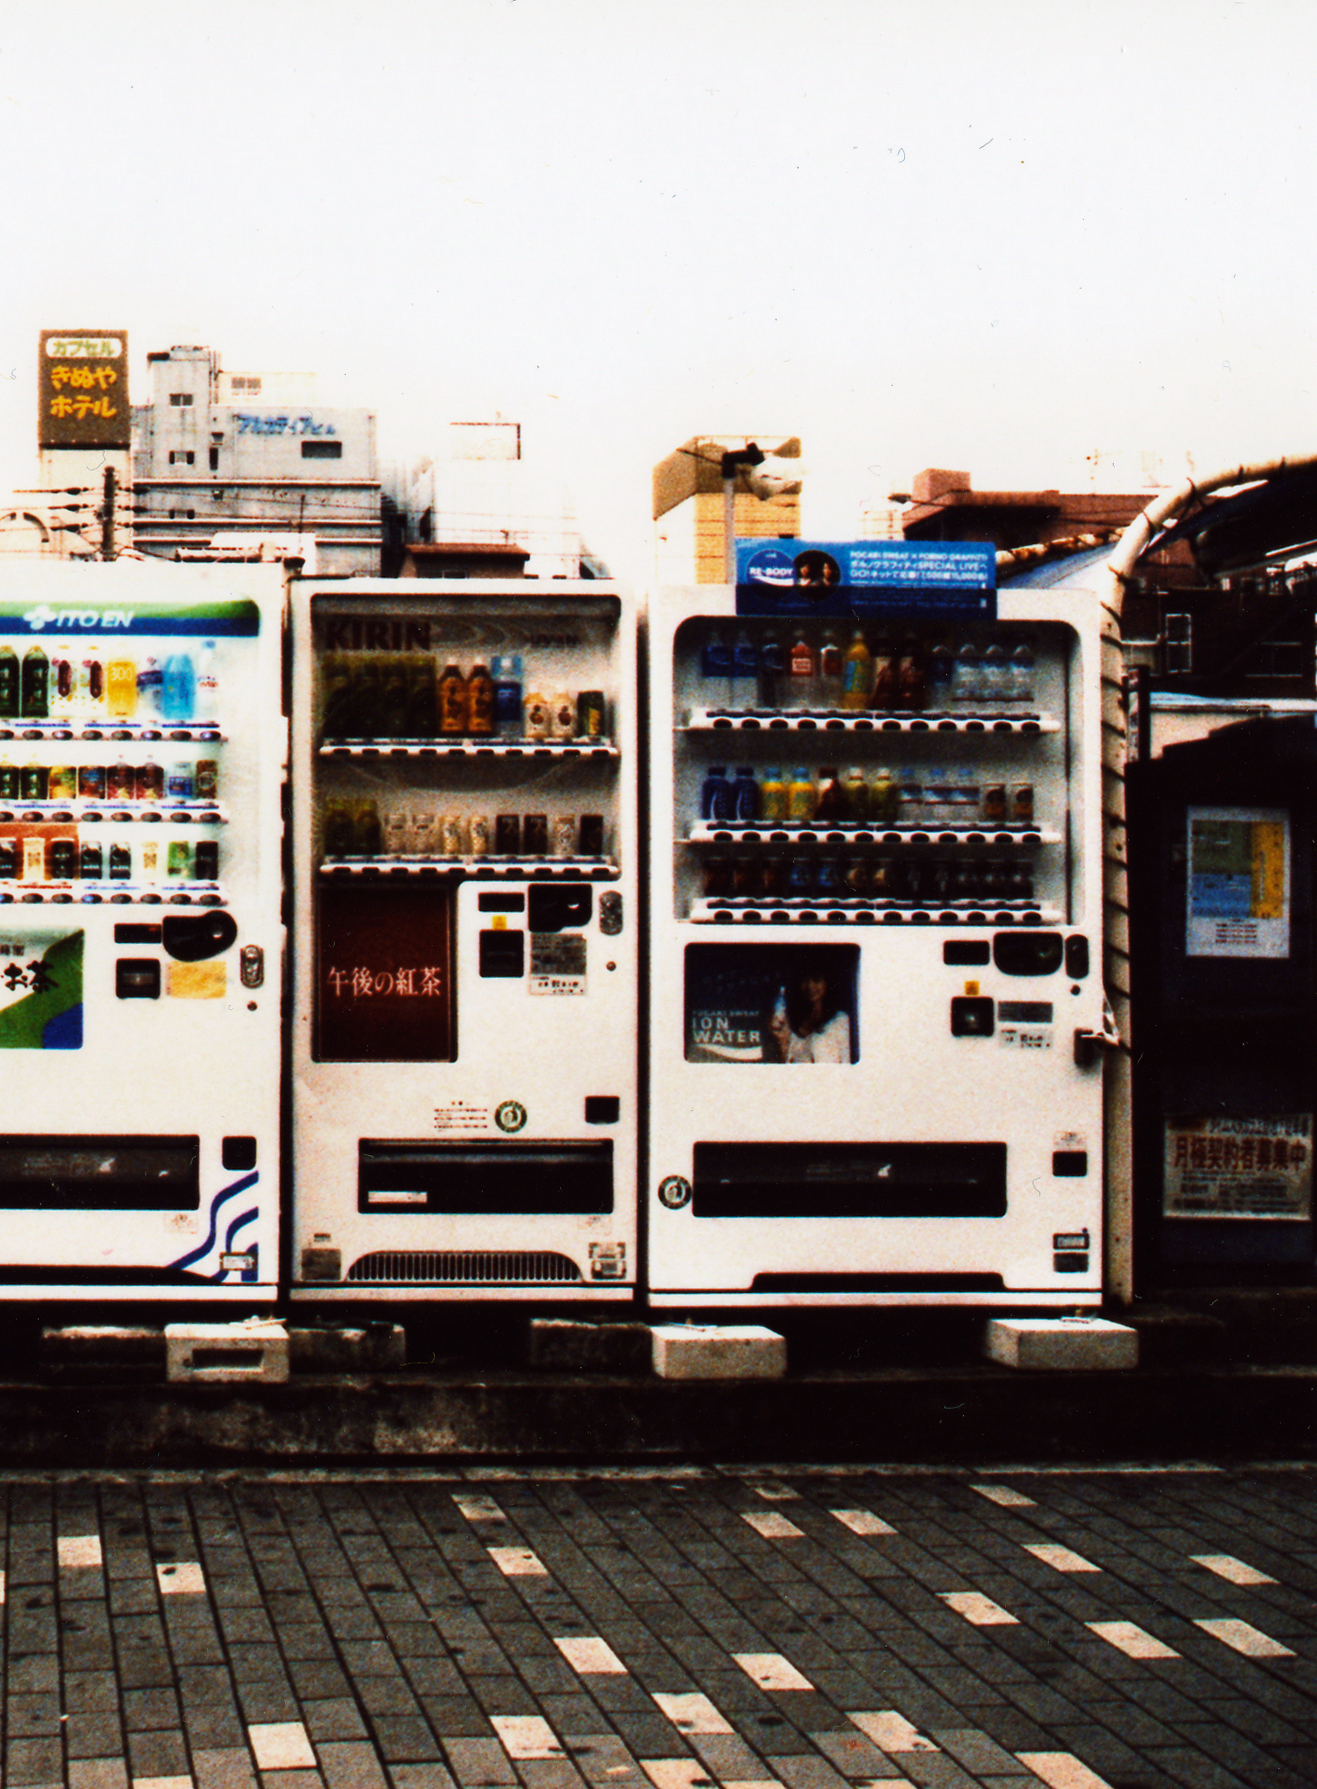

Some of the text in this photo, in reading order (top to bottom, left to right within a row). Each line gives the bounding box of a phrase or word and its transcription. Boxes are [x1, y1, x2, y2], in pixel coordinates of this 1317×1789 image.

[52, 340, 115, 357] カプセル
[50, 365, 118, 390] きぬや
[50, 395, 118, 419] ホテル
[324, 620, 432, 651] KIRIN
[327, 966, 442, 998] 午後の紅茶
[692, 1017, 729, 1030] ION
[692, 1029, 760, 1043] WATER
